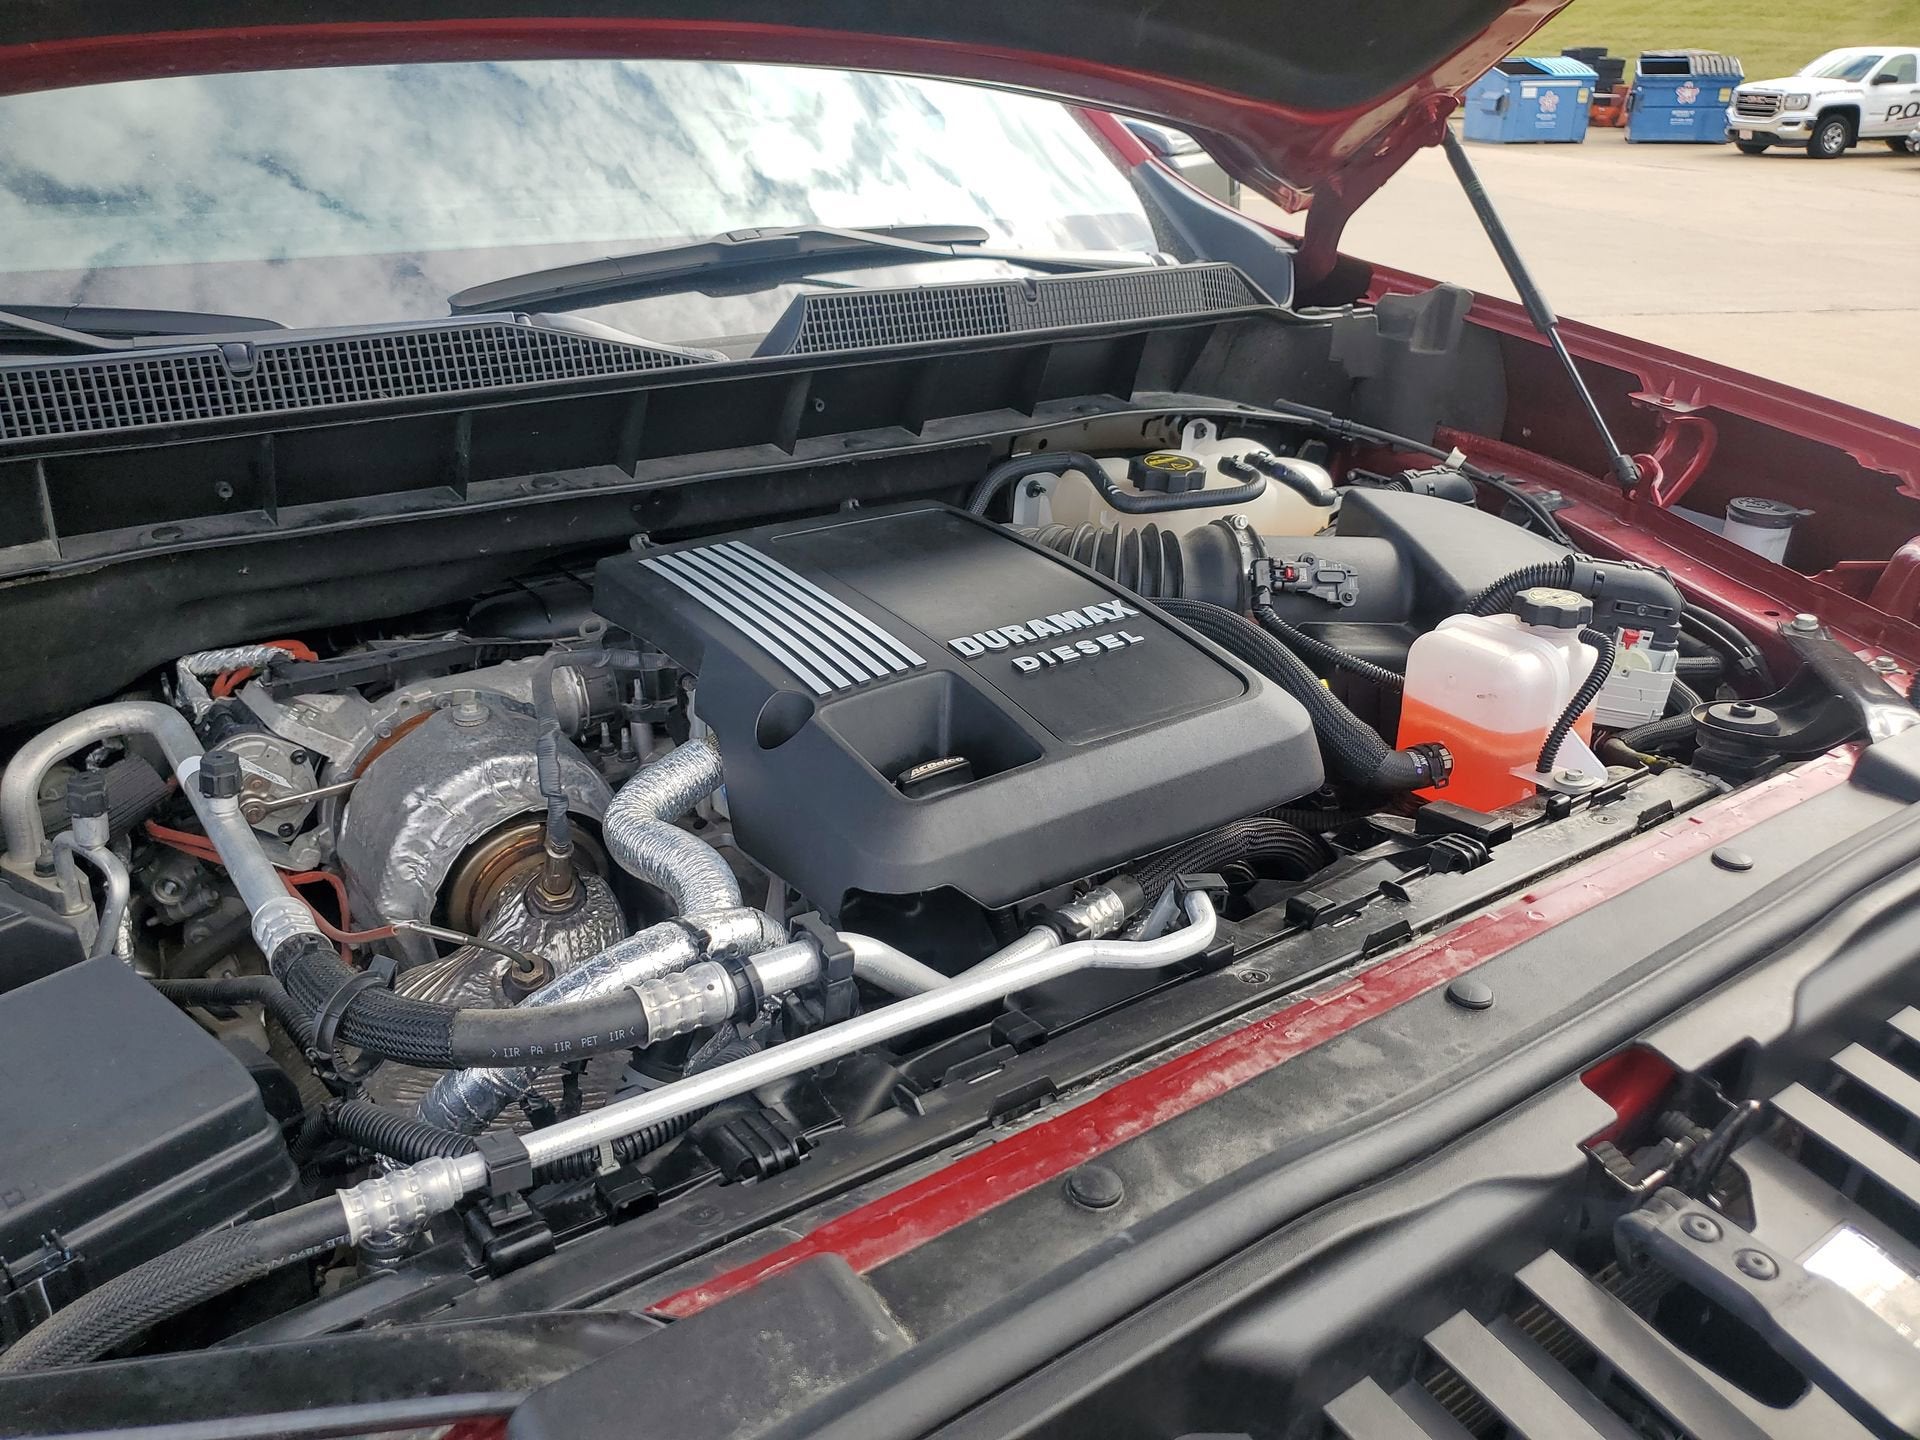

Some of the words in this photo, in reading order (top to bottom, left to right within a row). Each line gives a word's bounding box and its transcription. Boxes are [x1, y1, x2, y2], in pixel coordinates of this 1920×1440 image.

[947, 599, 1140, 658] DURAMAX
[1011, 630, 1145, 674] DIESEL
[910, 756, 964, 778] ACDelco
[503, 1046, 521, 1058] IIR
[530, 1045, 543, 1056] PA
[554, 1040, 572, 1053] IIR
[581, 1035, 598, 1048] PET
[609, 1029, 625, 1042] IIR
